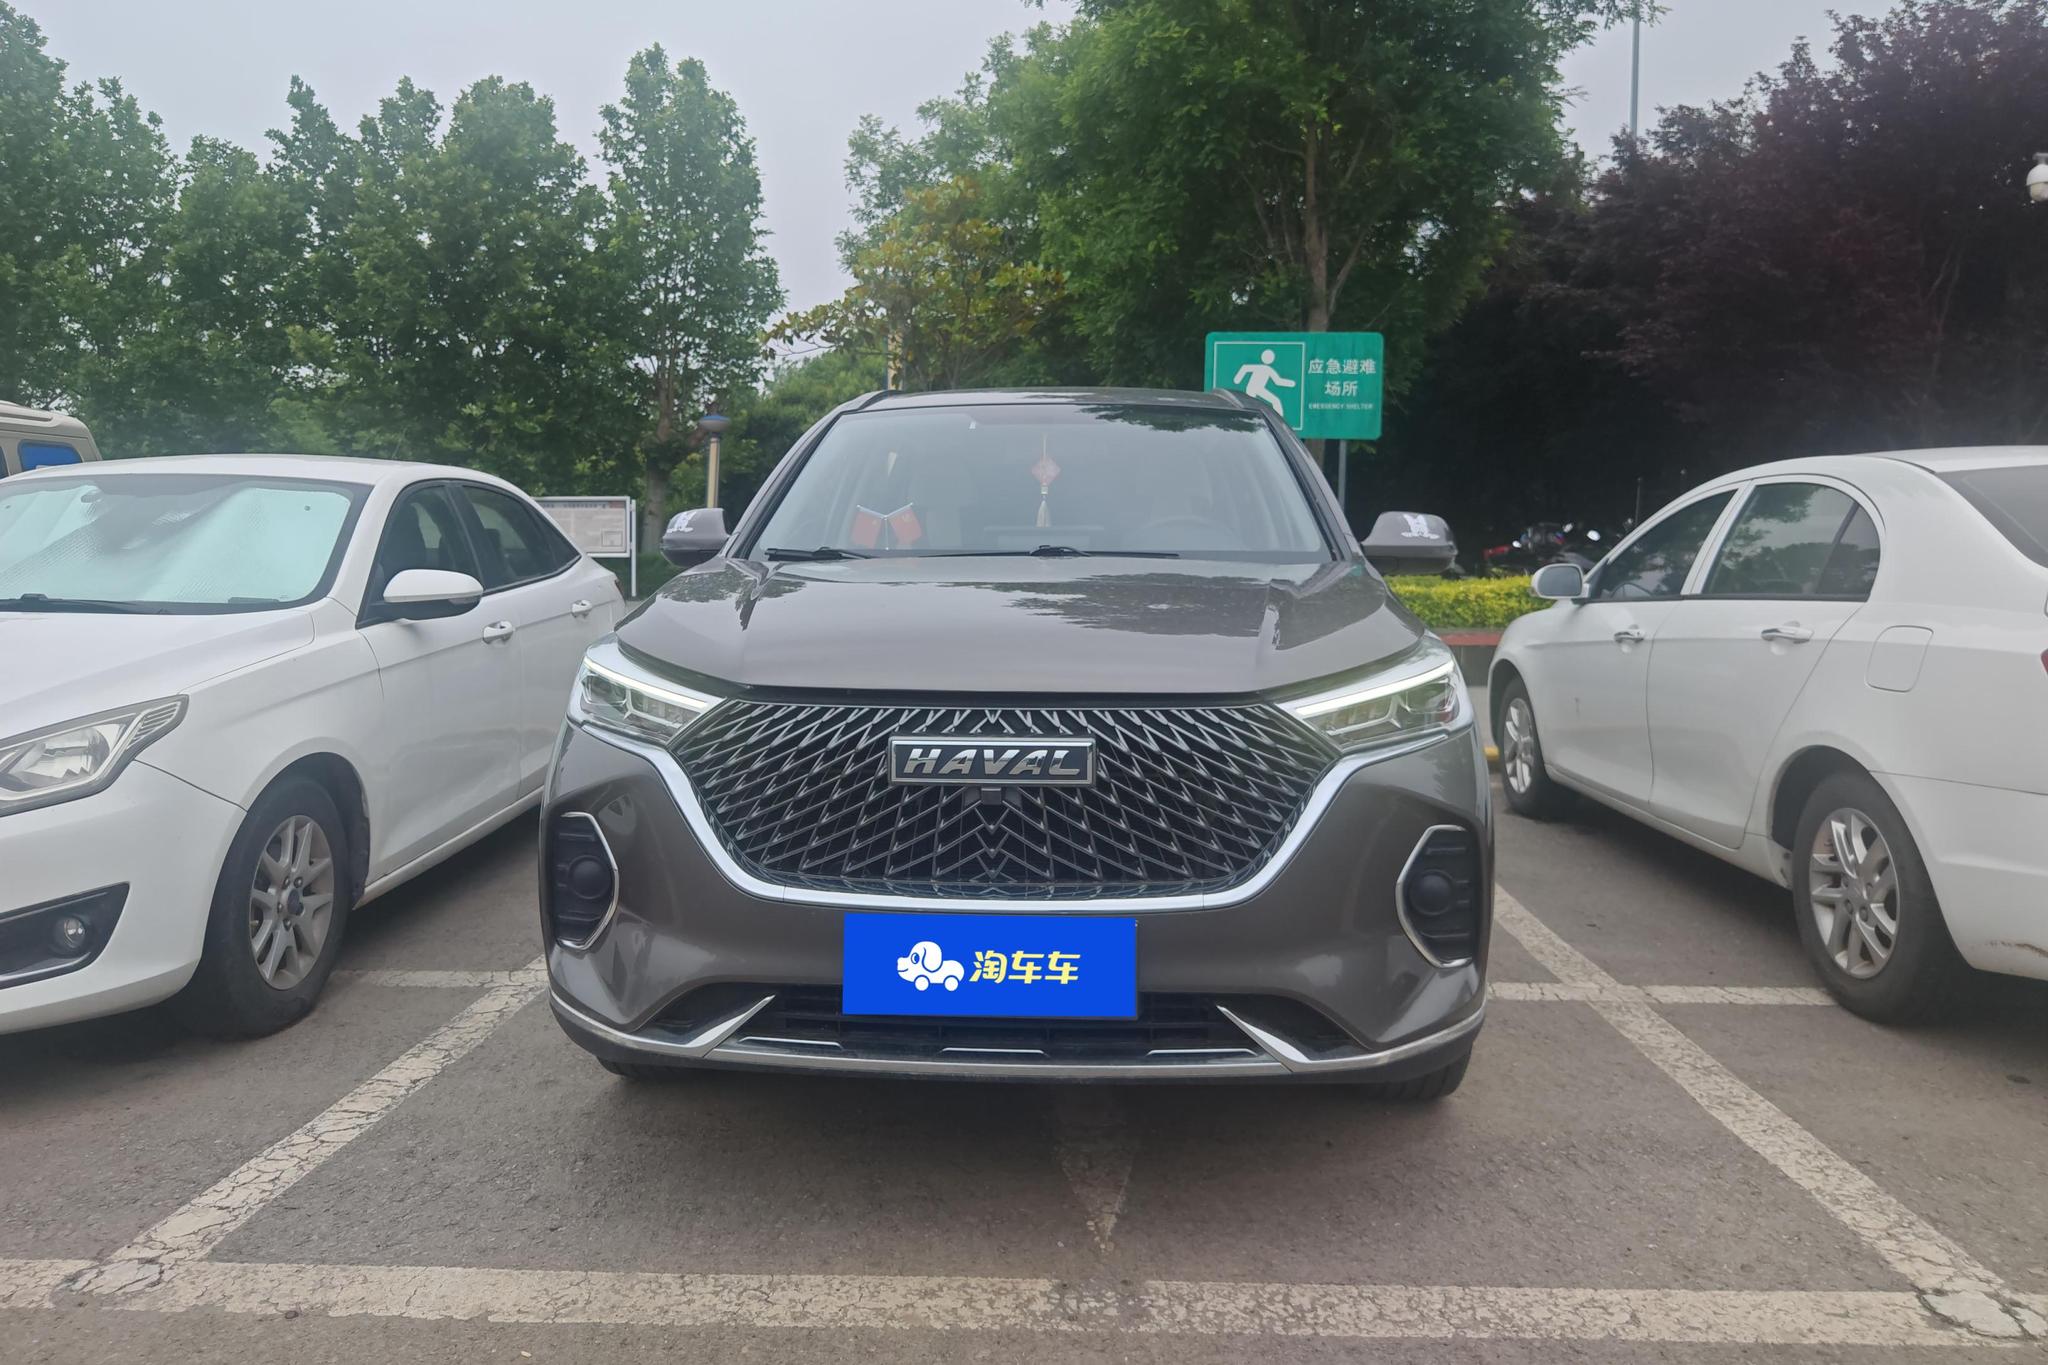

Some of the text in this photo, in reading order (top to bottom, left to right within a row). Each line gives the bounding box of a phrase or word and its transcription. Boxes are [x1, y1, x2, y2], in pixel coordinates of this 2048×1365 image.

[1308, 358, 1376, 375] 应急避难
[1325, 380, 1358, 397] 场所
[903, 748, 1080, 775] HAVAL
